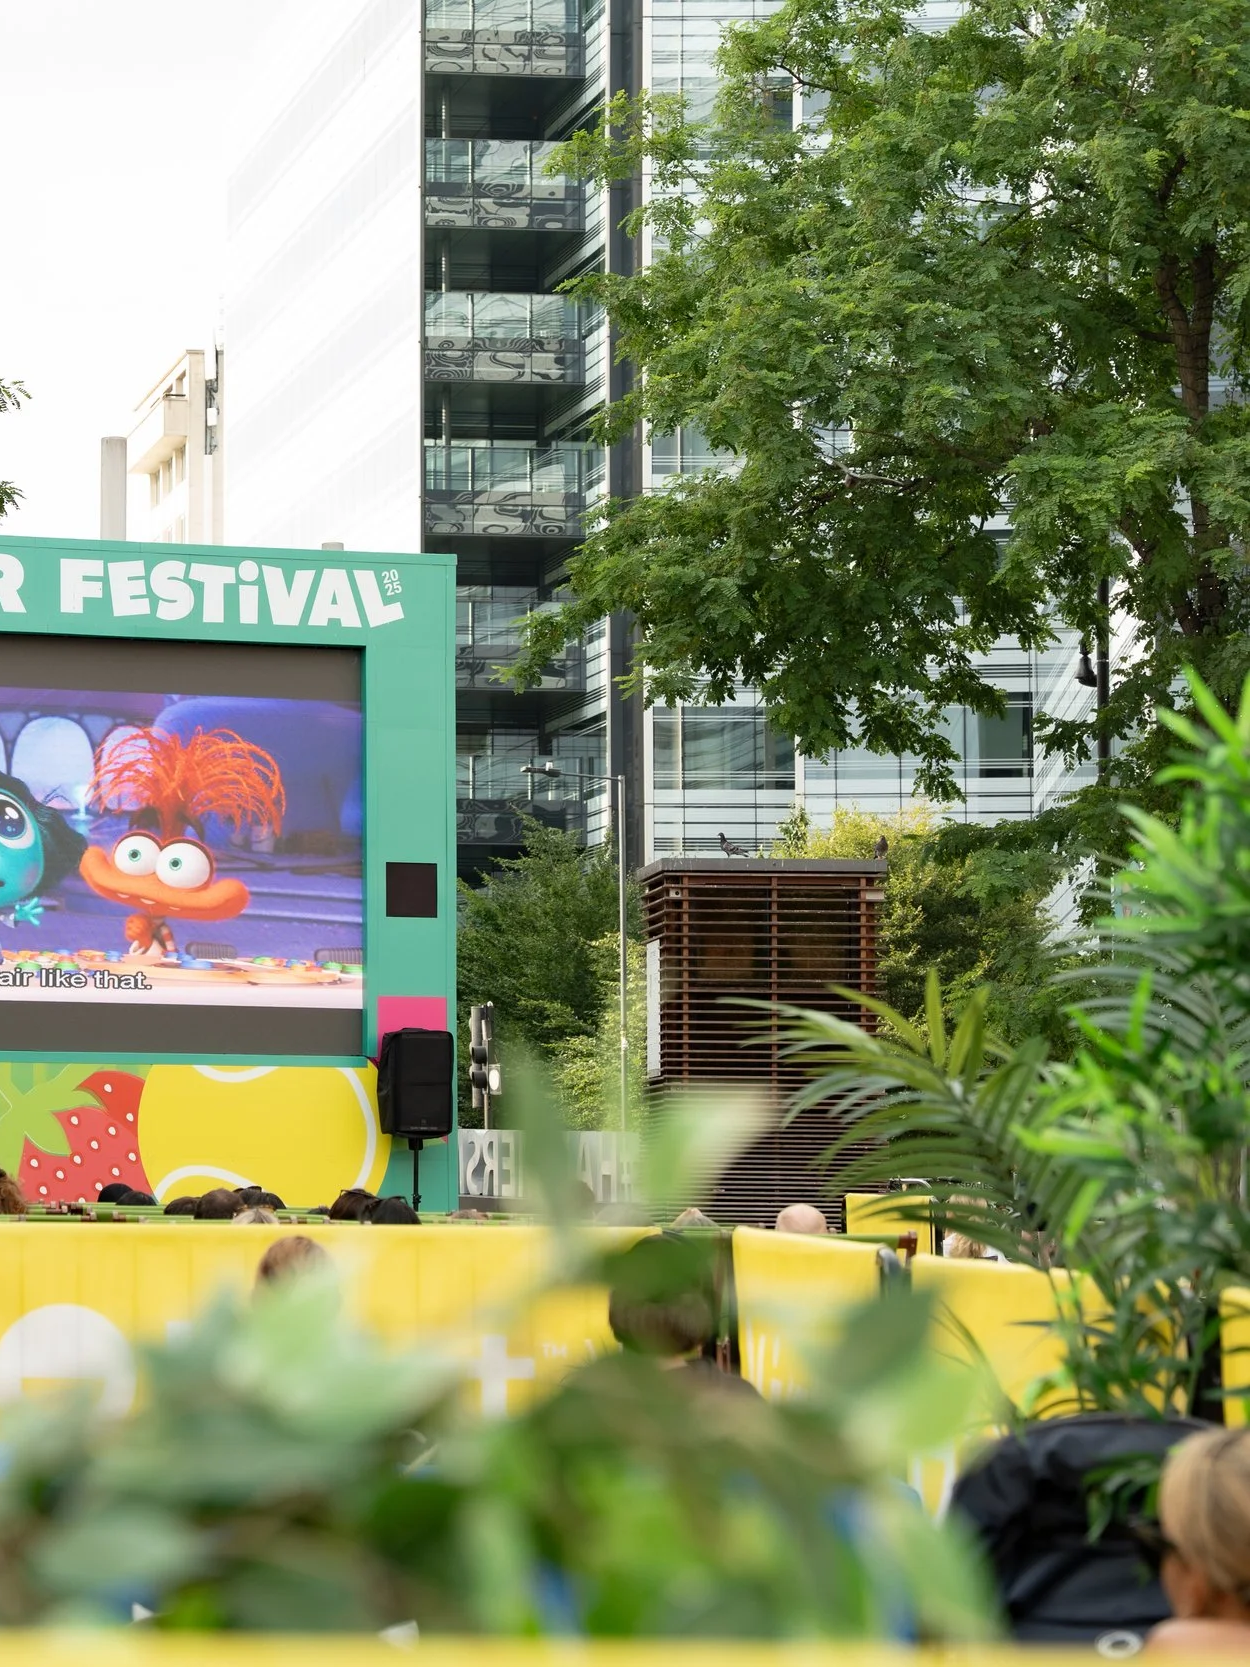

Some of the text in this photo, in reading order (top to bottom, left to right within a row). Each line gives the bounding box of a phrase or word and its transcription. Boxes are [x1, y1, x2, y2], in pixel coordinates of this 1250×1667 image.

[381, 569, 399, 583] 20
[384, 581, 402, 596] 25
[40, 969, 87, 988] like
[93, 970, 153, 990] that.
